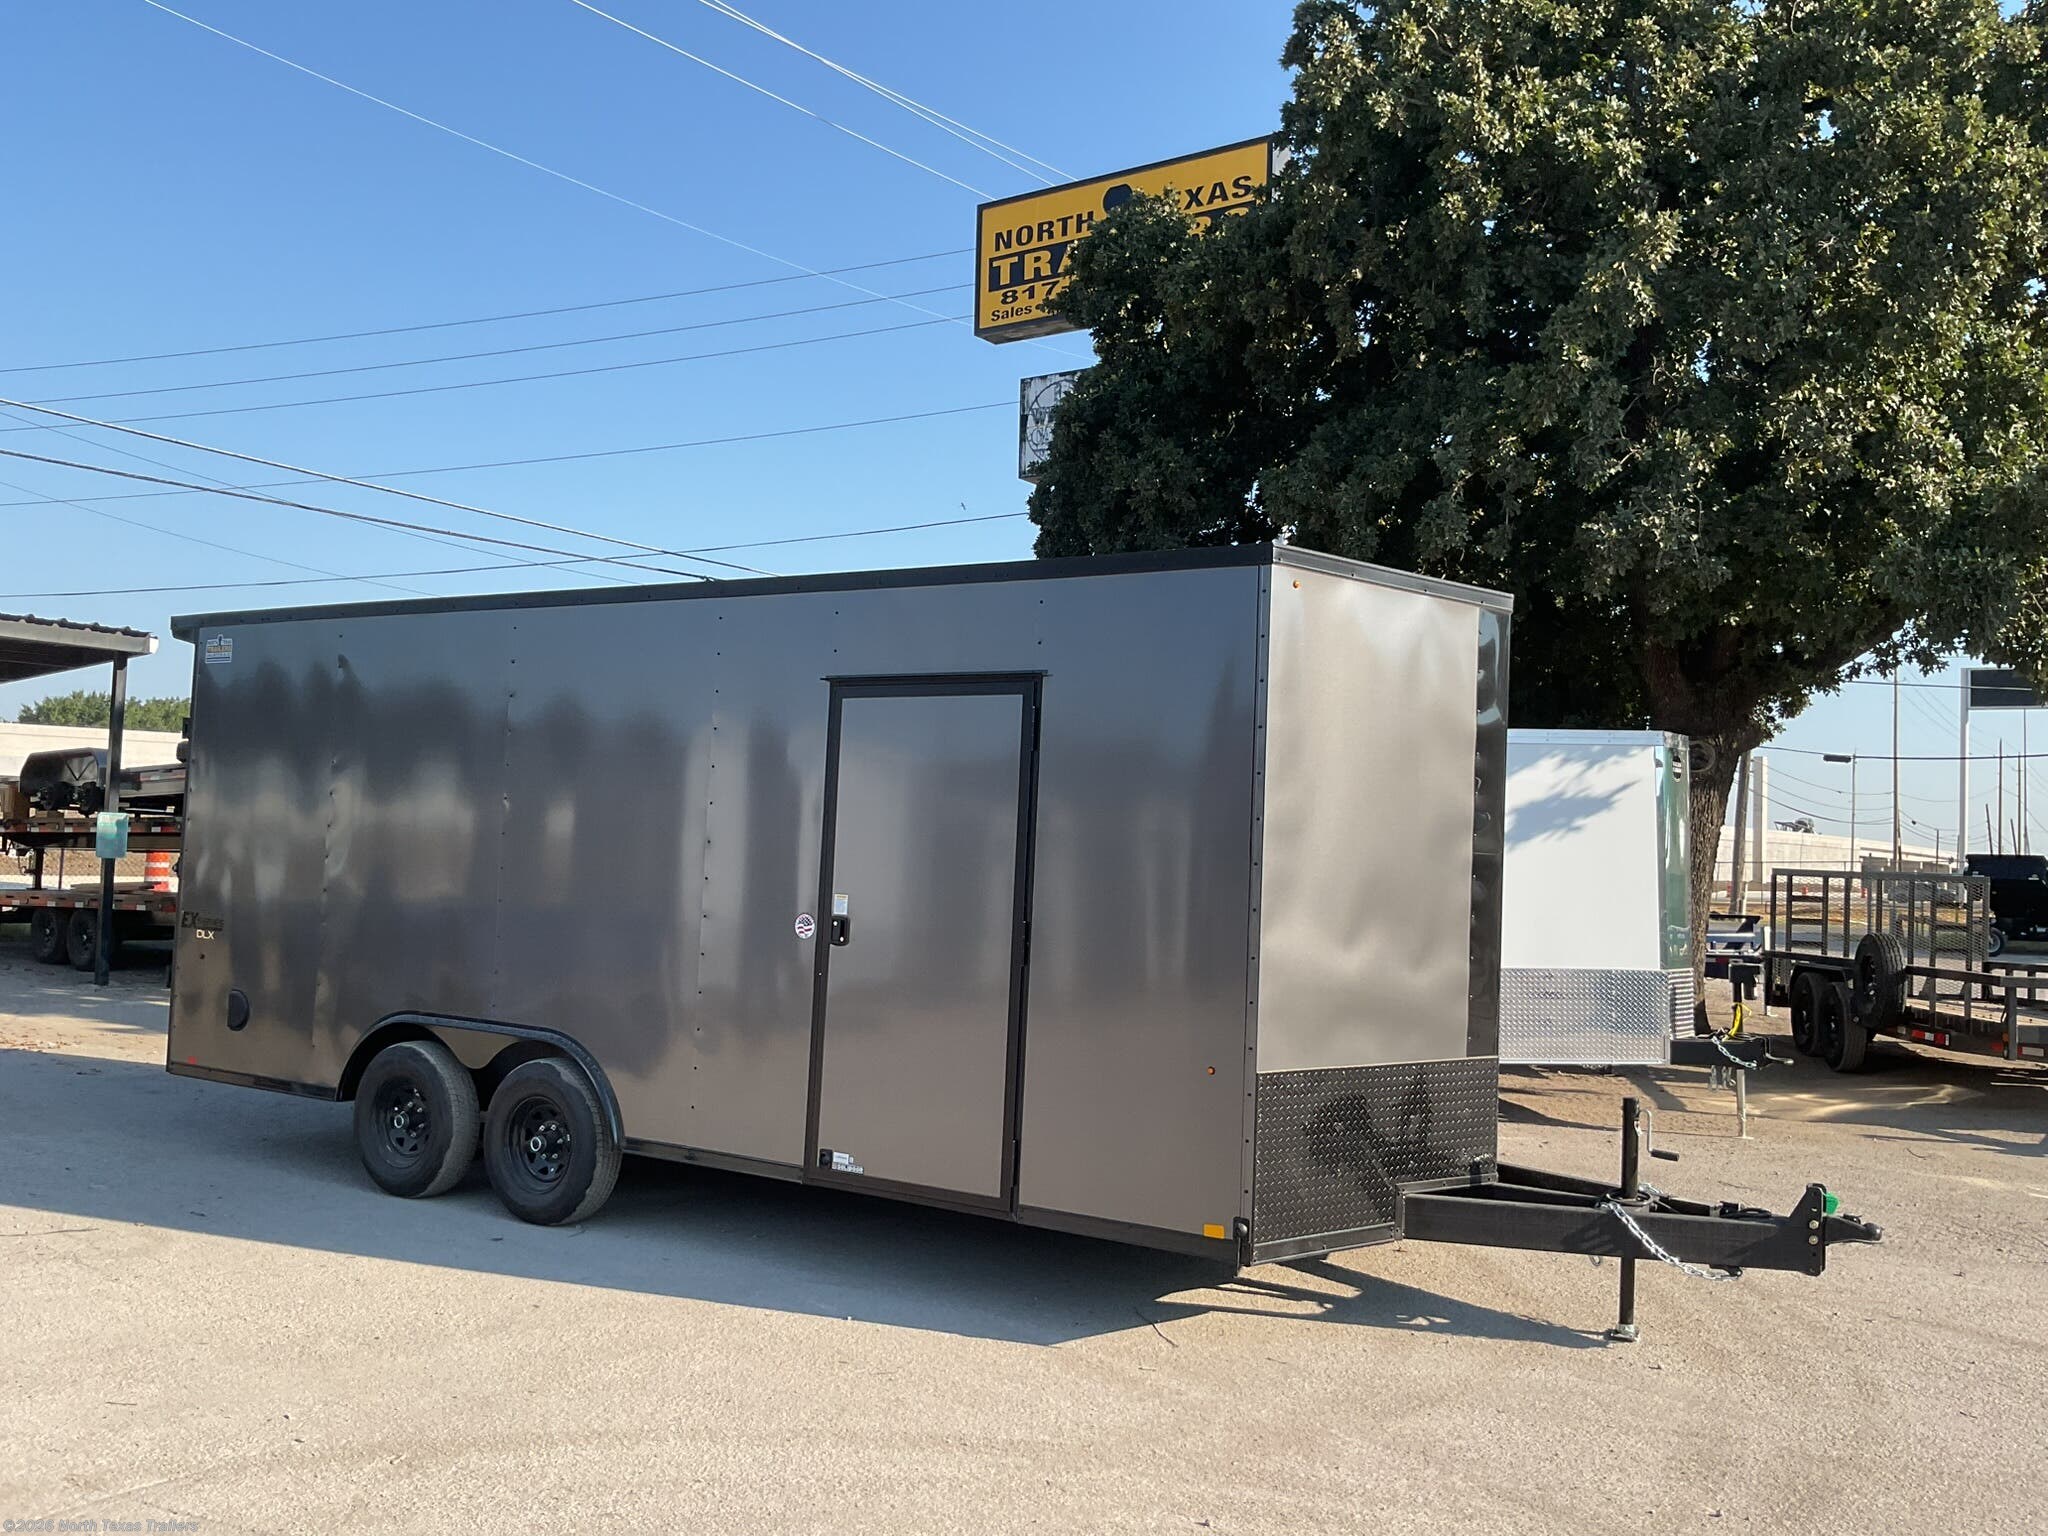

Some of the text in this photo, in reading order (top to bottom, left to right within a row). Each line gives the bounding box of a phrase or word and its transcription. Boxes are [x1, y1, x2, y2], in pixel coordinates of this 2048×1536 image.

[994, 175, 1253, 252] NORTH XAS
[990, 304, 1034, 322] Sales
[196, 929, 215, 940] DLX
